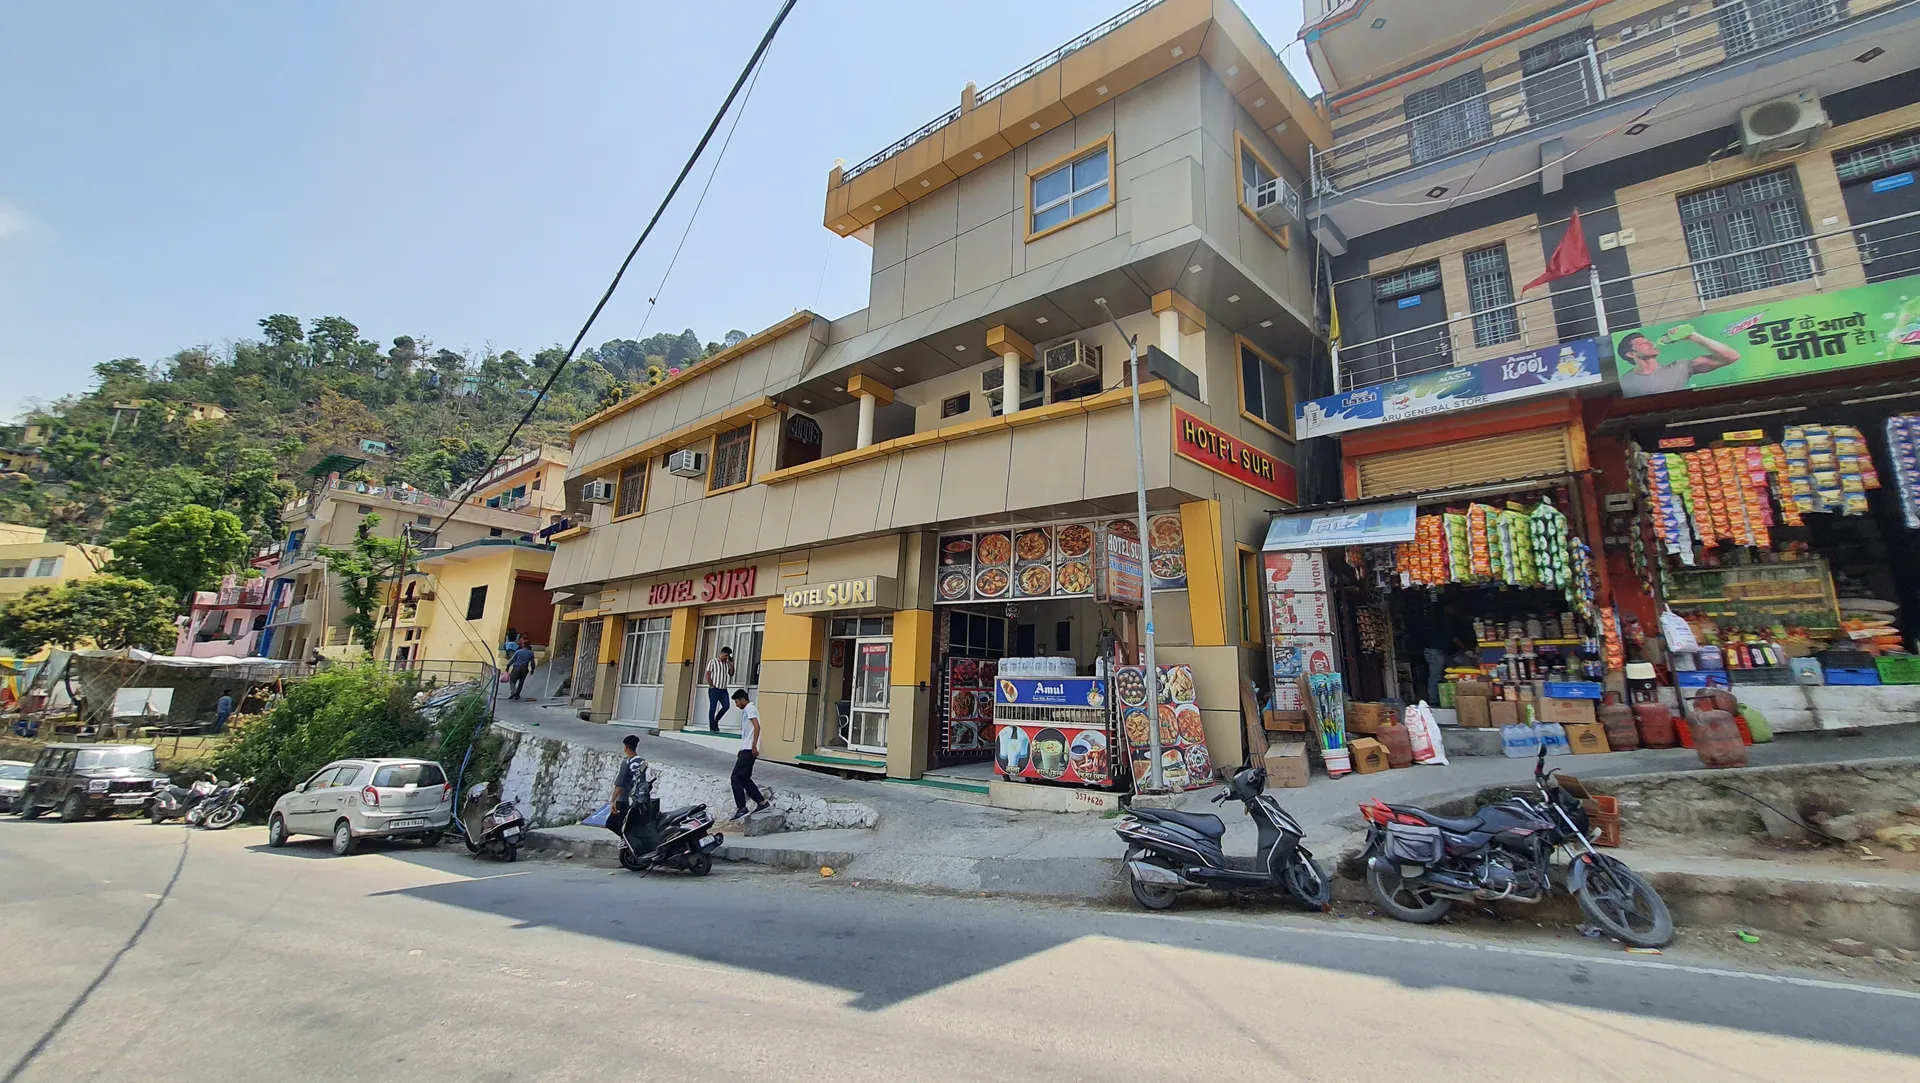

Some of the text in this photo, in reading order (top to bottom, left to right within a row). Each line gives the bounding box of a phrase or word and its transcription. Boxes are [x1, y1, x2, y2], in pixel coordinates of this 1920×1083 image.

[1747, 317, 1795, 346] डर
[1797, 314, 1816, 330] के
[1818, 312, 1867, 331] आगे
[1770, 330, 1849, 360] जीत
[1439, 371, 1472, 382] MASTI
[1501, 356, 1548, 380] KOOL
[1382, 395, 1489, 423] ARU GENERAL STORE
[1240, 448, 1275, 482] SURI
[1108, 533, 1130, 557] HOTEL
[648, 566, 757, 606] HOTEL SURI
[1311, 560, 1321, 587] INDIA
[783, 579, 875, 608] HOTEL SURI
[1315, 603, 1324, 618] Top
[1034, 682, 1064, 695] Amul
